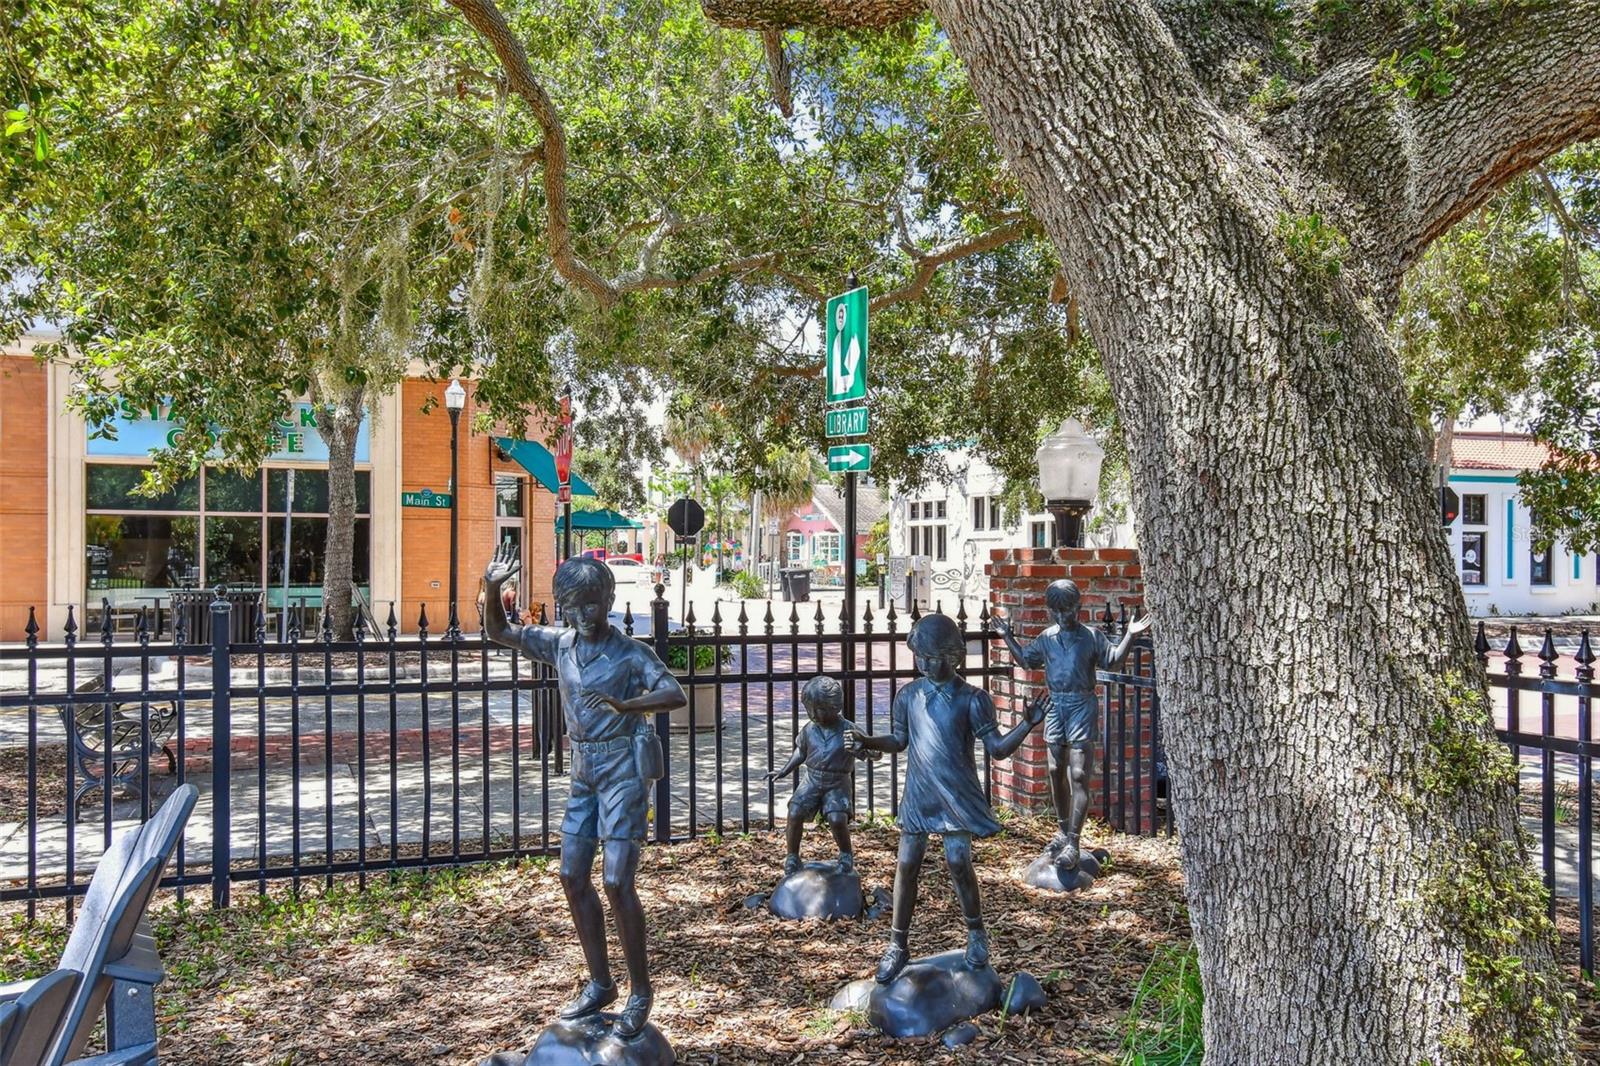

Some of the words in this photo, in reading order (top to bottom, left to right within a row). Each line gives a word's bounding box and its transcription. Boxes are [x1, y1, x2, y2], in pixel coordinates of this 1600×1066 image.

[829, 411, 865, 434] LIBRARY
[406, 494, 430, 506] Main
[435, 495, 446, 507] St
